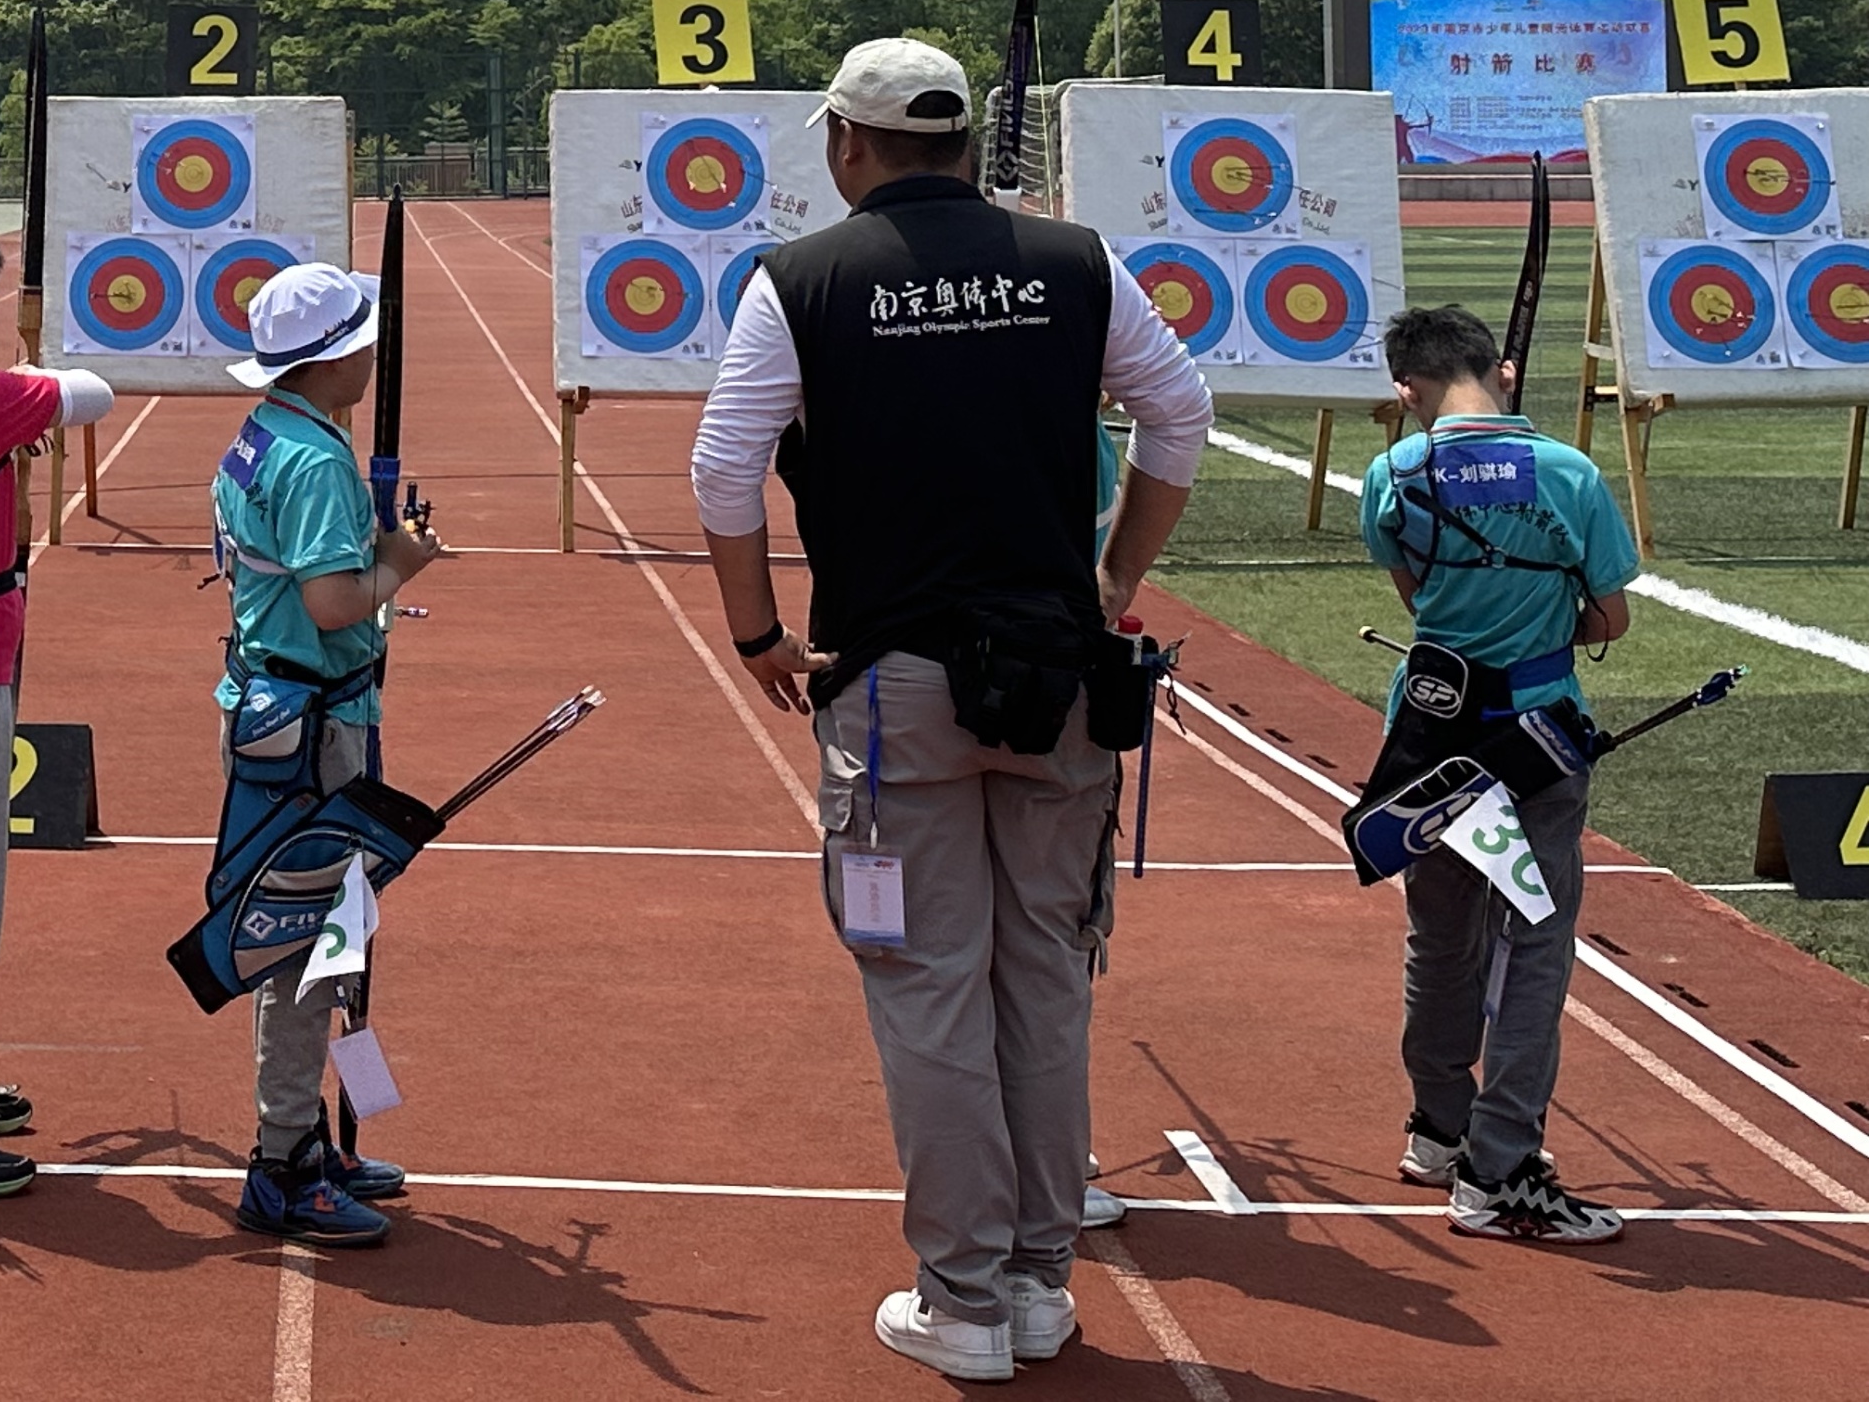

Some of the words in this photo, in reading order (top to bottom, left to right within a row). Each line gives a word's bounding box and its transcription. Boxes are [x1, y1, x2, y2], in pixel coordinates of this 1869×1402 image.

[191, 14, 238, 84] 2
[680, 4, 728, 74] 3
[1187, 10, 1242, 81] 4
[872, 323, 922, 337] Nanjing
[922, 320, 970, 334] Olympic
[972, 318, 1011, 331] Sports
[1013, 314, 1051, 326] Center
